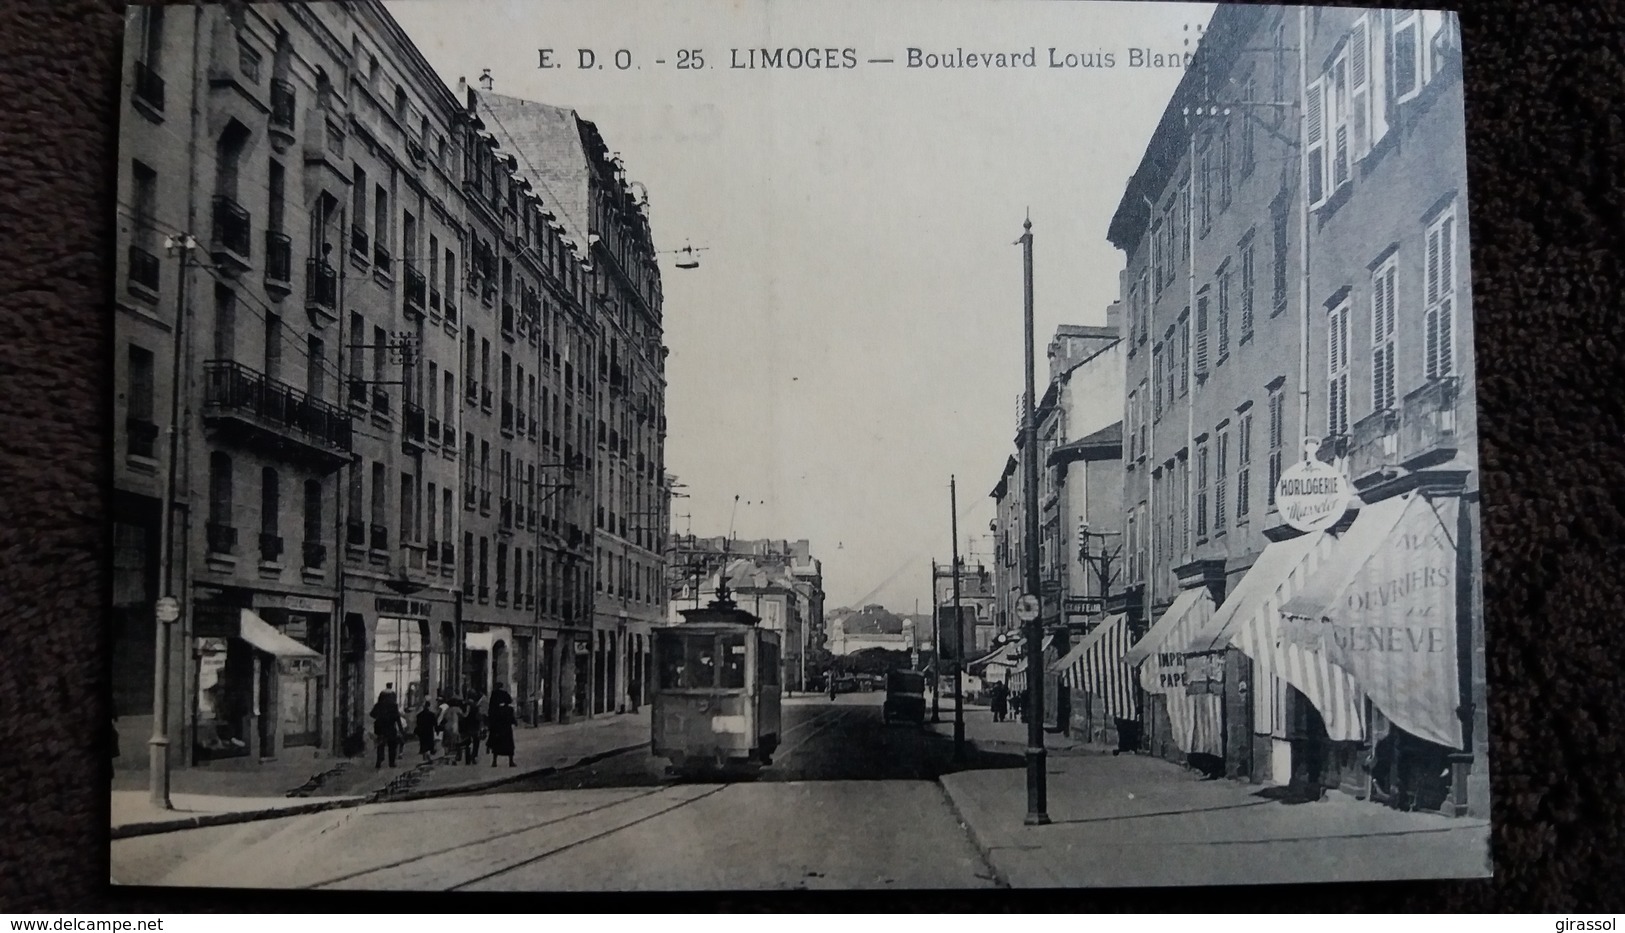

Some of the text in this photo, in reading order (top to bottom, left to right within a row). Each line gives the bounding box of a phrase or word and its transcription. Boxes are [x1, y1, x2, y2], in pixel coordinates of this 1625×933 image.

[537, 48, 562, 69] E.
[577, 48, 603, 70] D.
[729, 47, 857, 69] LIMOGES
[906, 46, 1037, 69] Boulevard
[1047, 47, 1115, 69] Louis
[1280, 476, 1339, 497] HORLOGERIE
[1346, 565, 1451, 612] OUVRIERS
